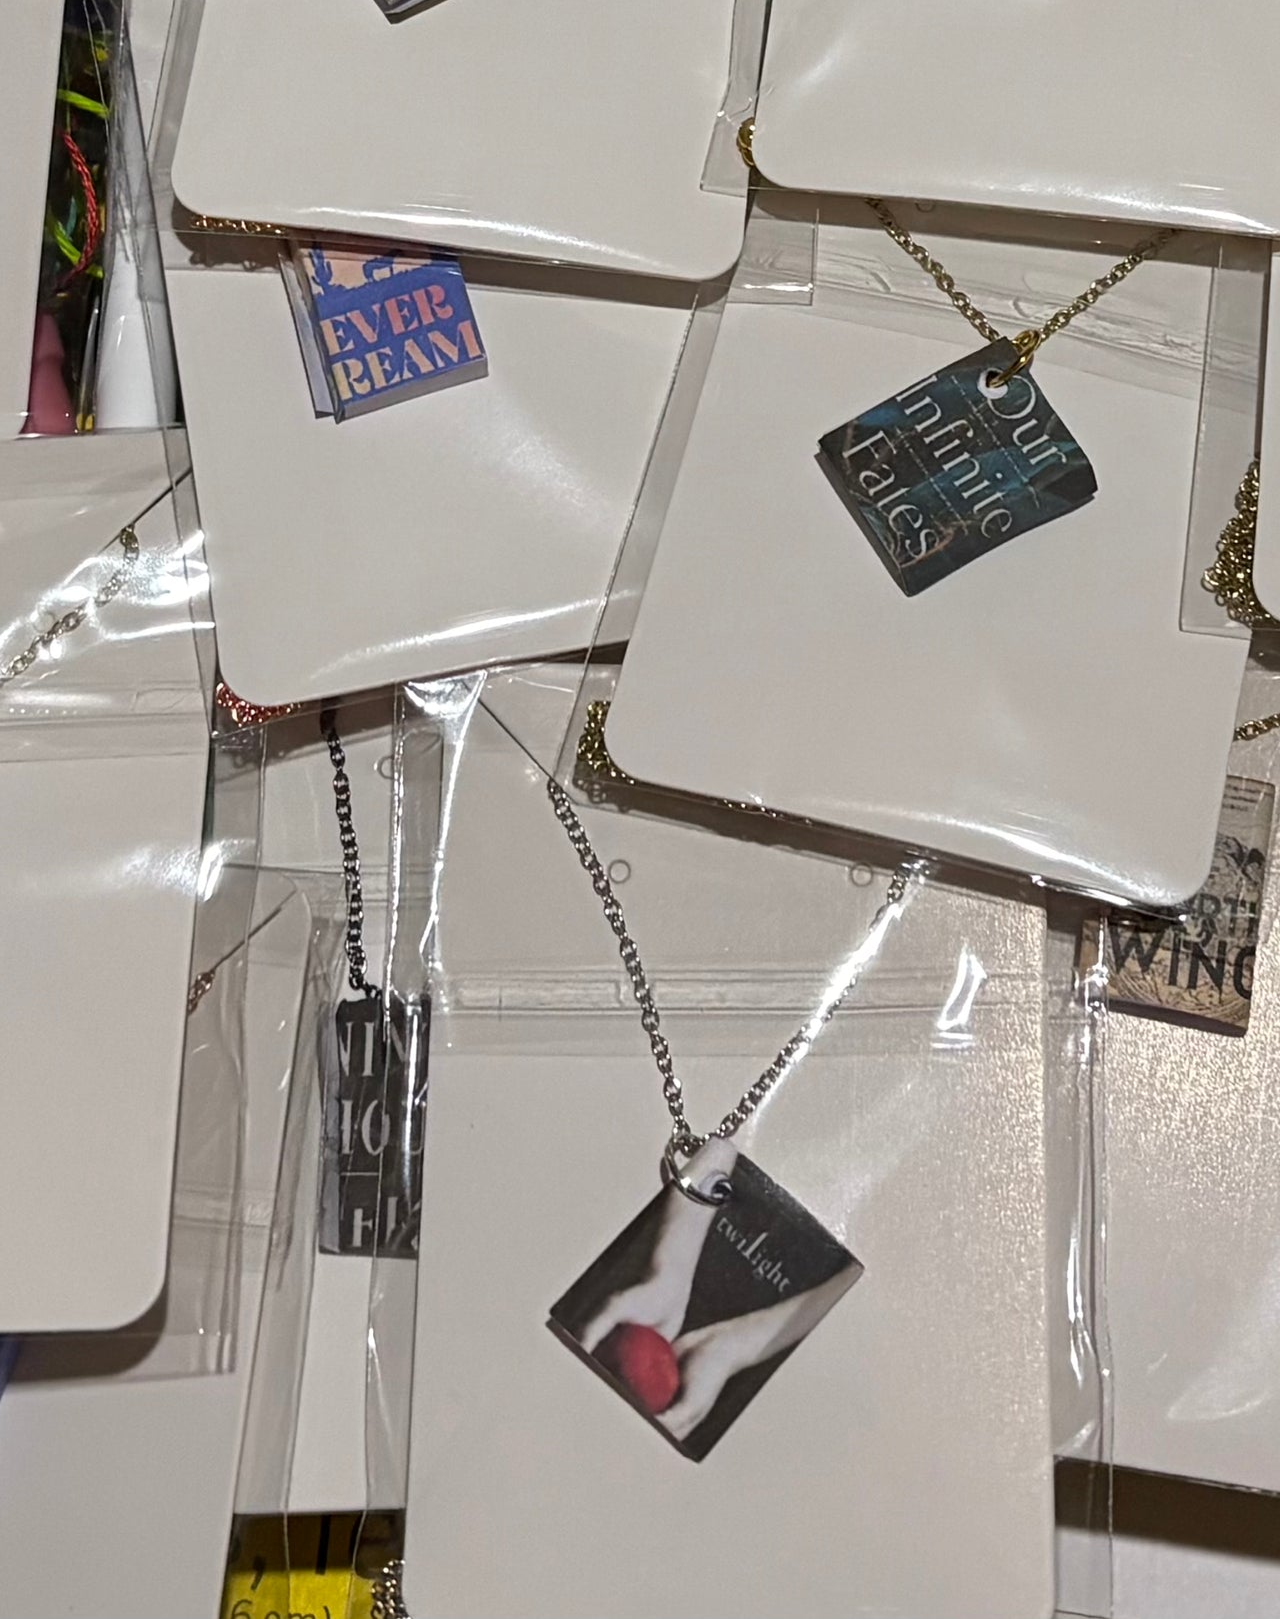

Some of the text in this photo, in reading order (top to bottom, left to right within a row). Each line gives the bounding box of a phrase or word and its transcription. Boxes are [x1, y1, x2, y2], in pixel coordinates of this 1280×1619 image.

[320, 284, 454, 357] EVER
[331, 320, 483, 401] REAM
[842, 430, 940, 560] Fates
[895, 374, 1014, 539] Infinite
[717, 1215, 790, 1293] twilight
